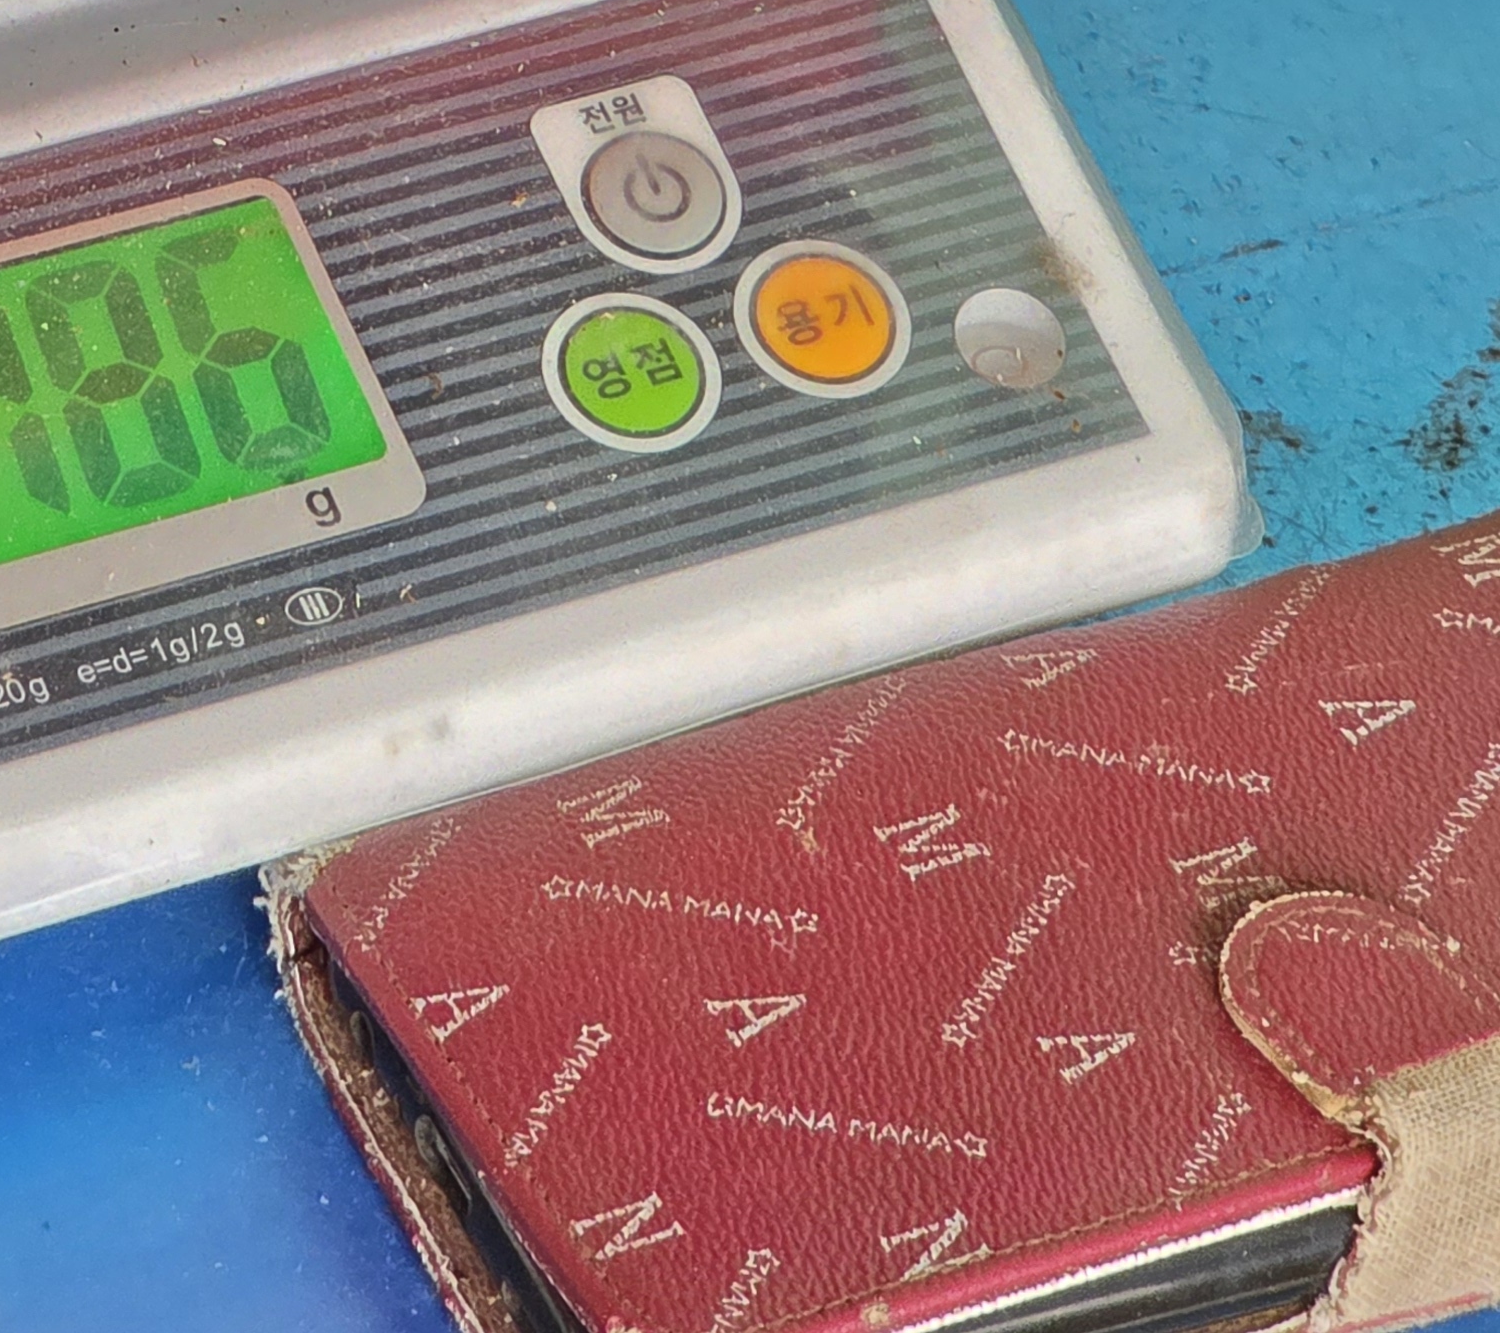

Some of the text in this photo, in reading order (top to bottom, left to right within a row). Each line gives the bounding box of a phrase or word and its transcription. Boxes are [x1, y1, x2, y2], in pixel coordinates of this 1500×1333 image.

[579, 93, 646, 134] 전원
[777, 285, 875, 346] 용기
[582, 338, 683, 399] 영점
[305, 485, 341, 527] g
[576, 881, 673, 913] MANA
